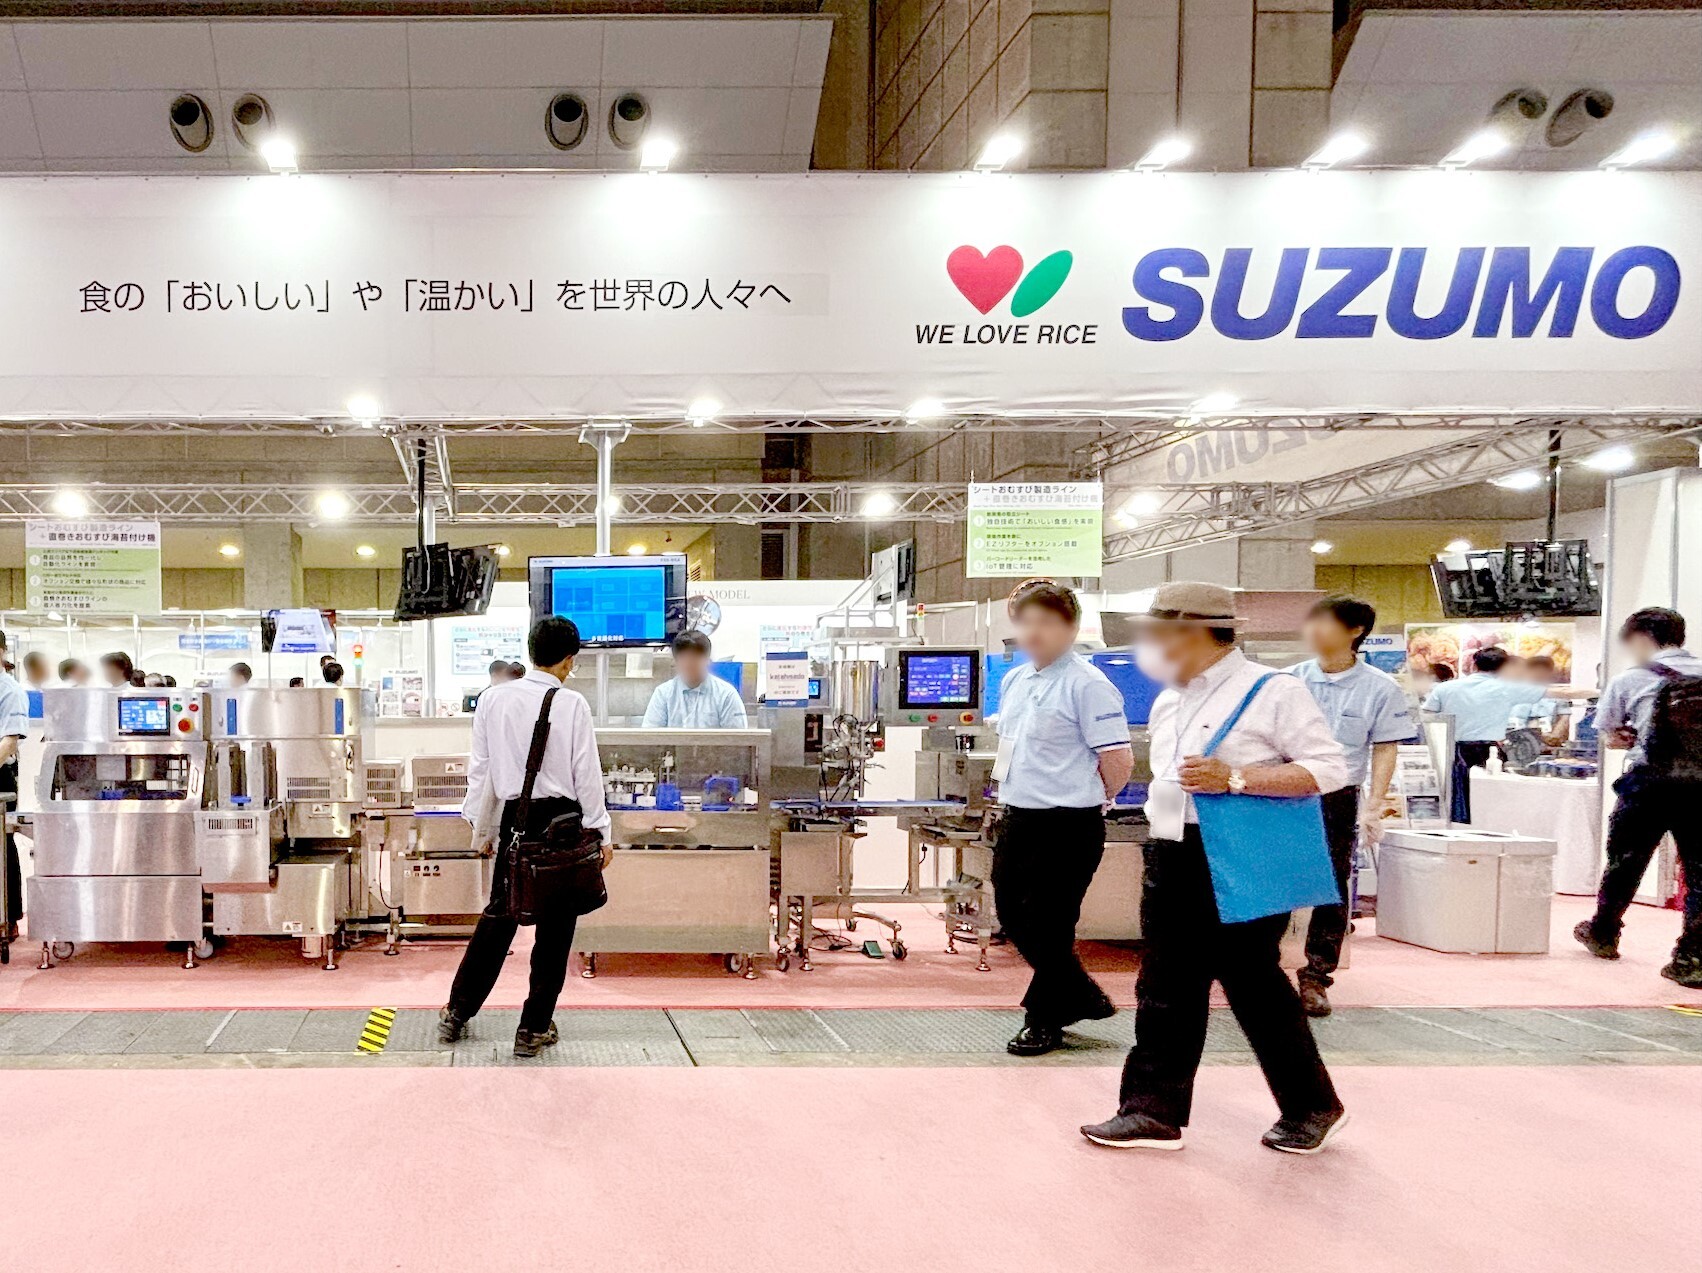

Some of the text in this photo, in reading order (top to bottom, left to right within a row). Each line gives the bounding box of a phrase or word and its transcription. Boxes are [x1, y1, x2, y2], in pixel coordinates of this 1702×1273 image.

[79, 279, 792, 313] 食の「おいしい」や「温かい」を世界の人々へ
[1123, 246, 1681, 342] SUZUMO
[916, 325, 1098, 344] WE LOVE RICE
[973, 485, 1077, 494] シートおむすび製造ライン
[49, 533, 156, 542] 直巻きおむすび海苔付け機
